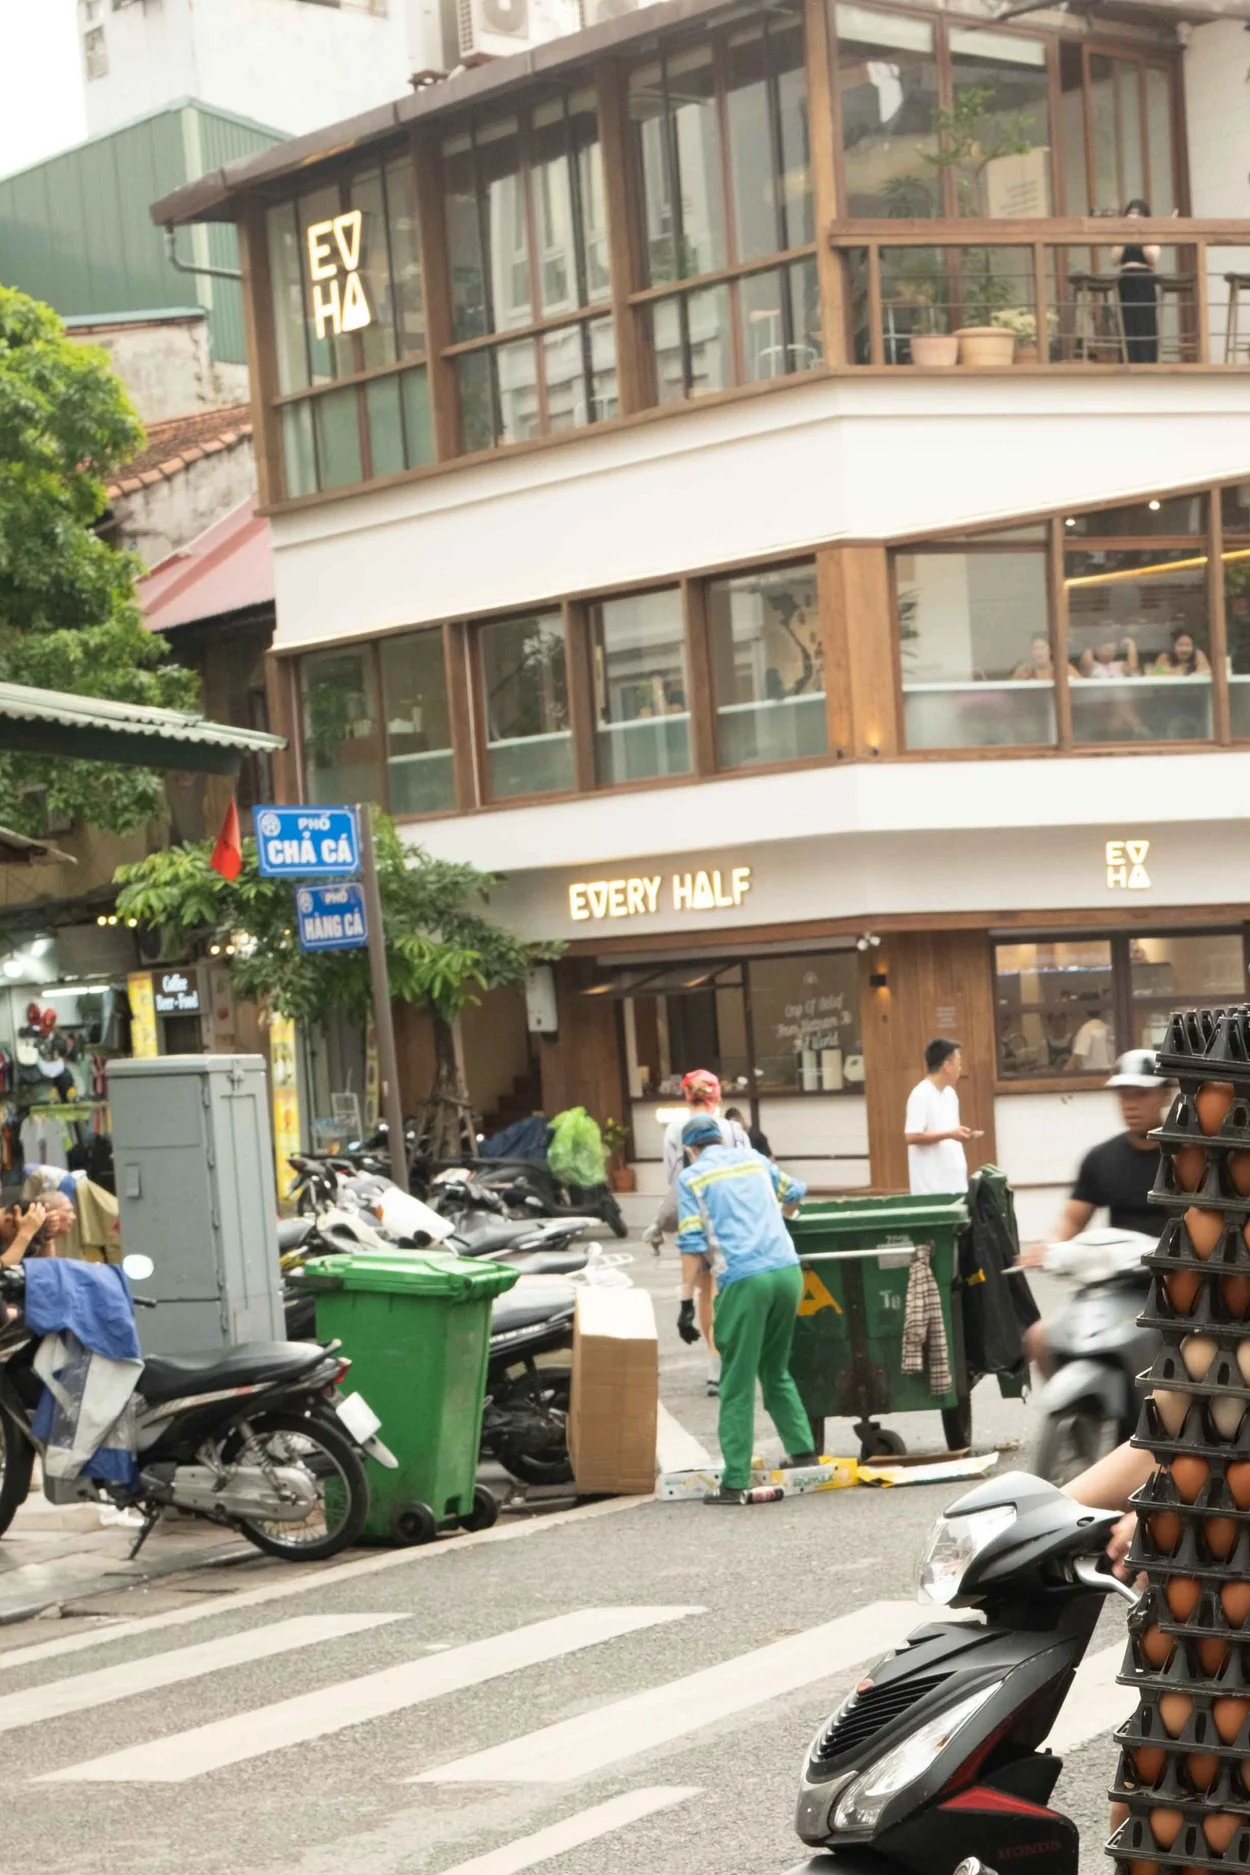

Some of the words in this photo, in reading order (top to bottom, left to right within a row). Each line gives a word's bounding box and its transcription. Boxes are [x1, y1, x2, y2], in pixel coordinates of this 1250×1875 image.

[298, 811, 330, 831] PHỐ
[267, 831, 317, 864] CHẢ
[320, 833, 353, 864] CÁ
[568, 875, 662, 921] EVERY
[672, 867, 751, 911] HALF
[304, 912, 343, 941] HÀNG
[343, 907, 364, 937] CÁ
[998, 1841, 1062, 1860] HONDA
